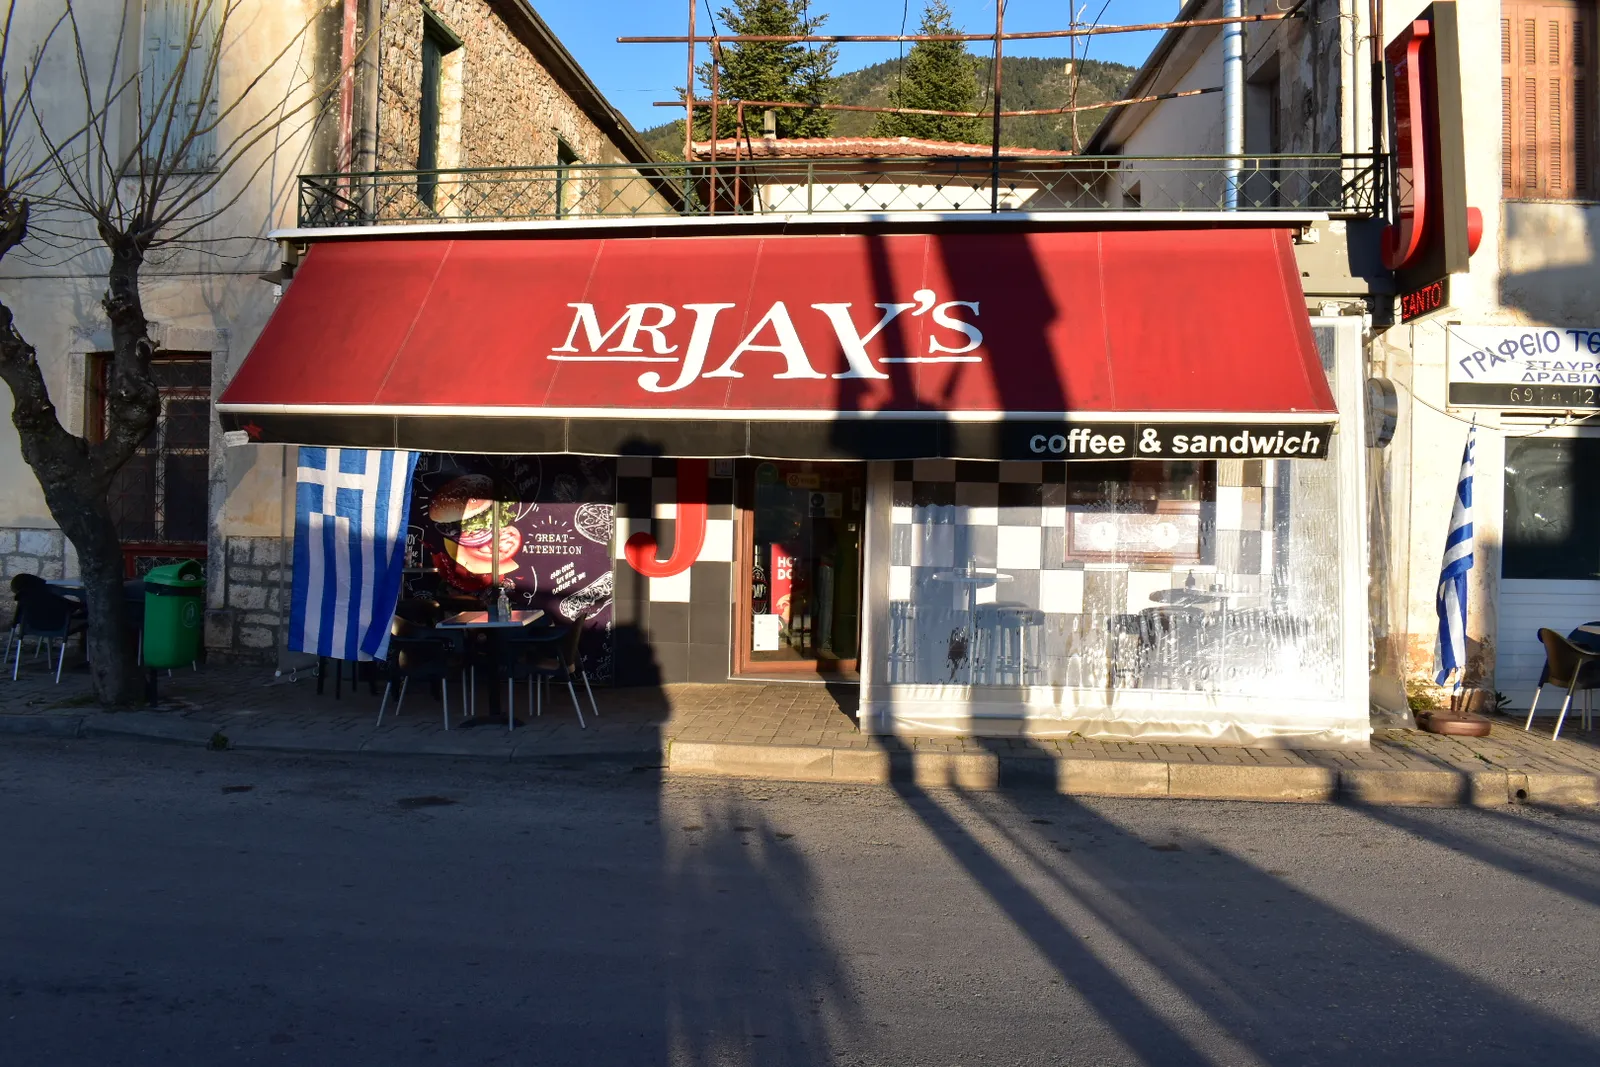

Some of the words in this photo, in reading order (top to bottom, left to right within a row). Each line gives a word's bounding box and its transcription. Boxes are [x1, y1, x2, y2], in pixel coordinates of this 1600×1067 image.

[1402, 279, 1443, 319] ΣΑΝΤΟ
[551, 302, 679, 353] MR
[637, 289, 984, 393] JAY'S
[1459, 330, 1560, 379] ΓΡΑΦΕΙΟ
[1029, 428, 1126, 454] coffee
[1138, 428, 1163, 453] &
[1171, 430, 1321, 455] sandwich
[521, 545, 583, 555] ATTENTION
